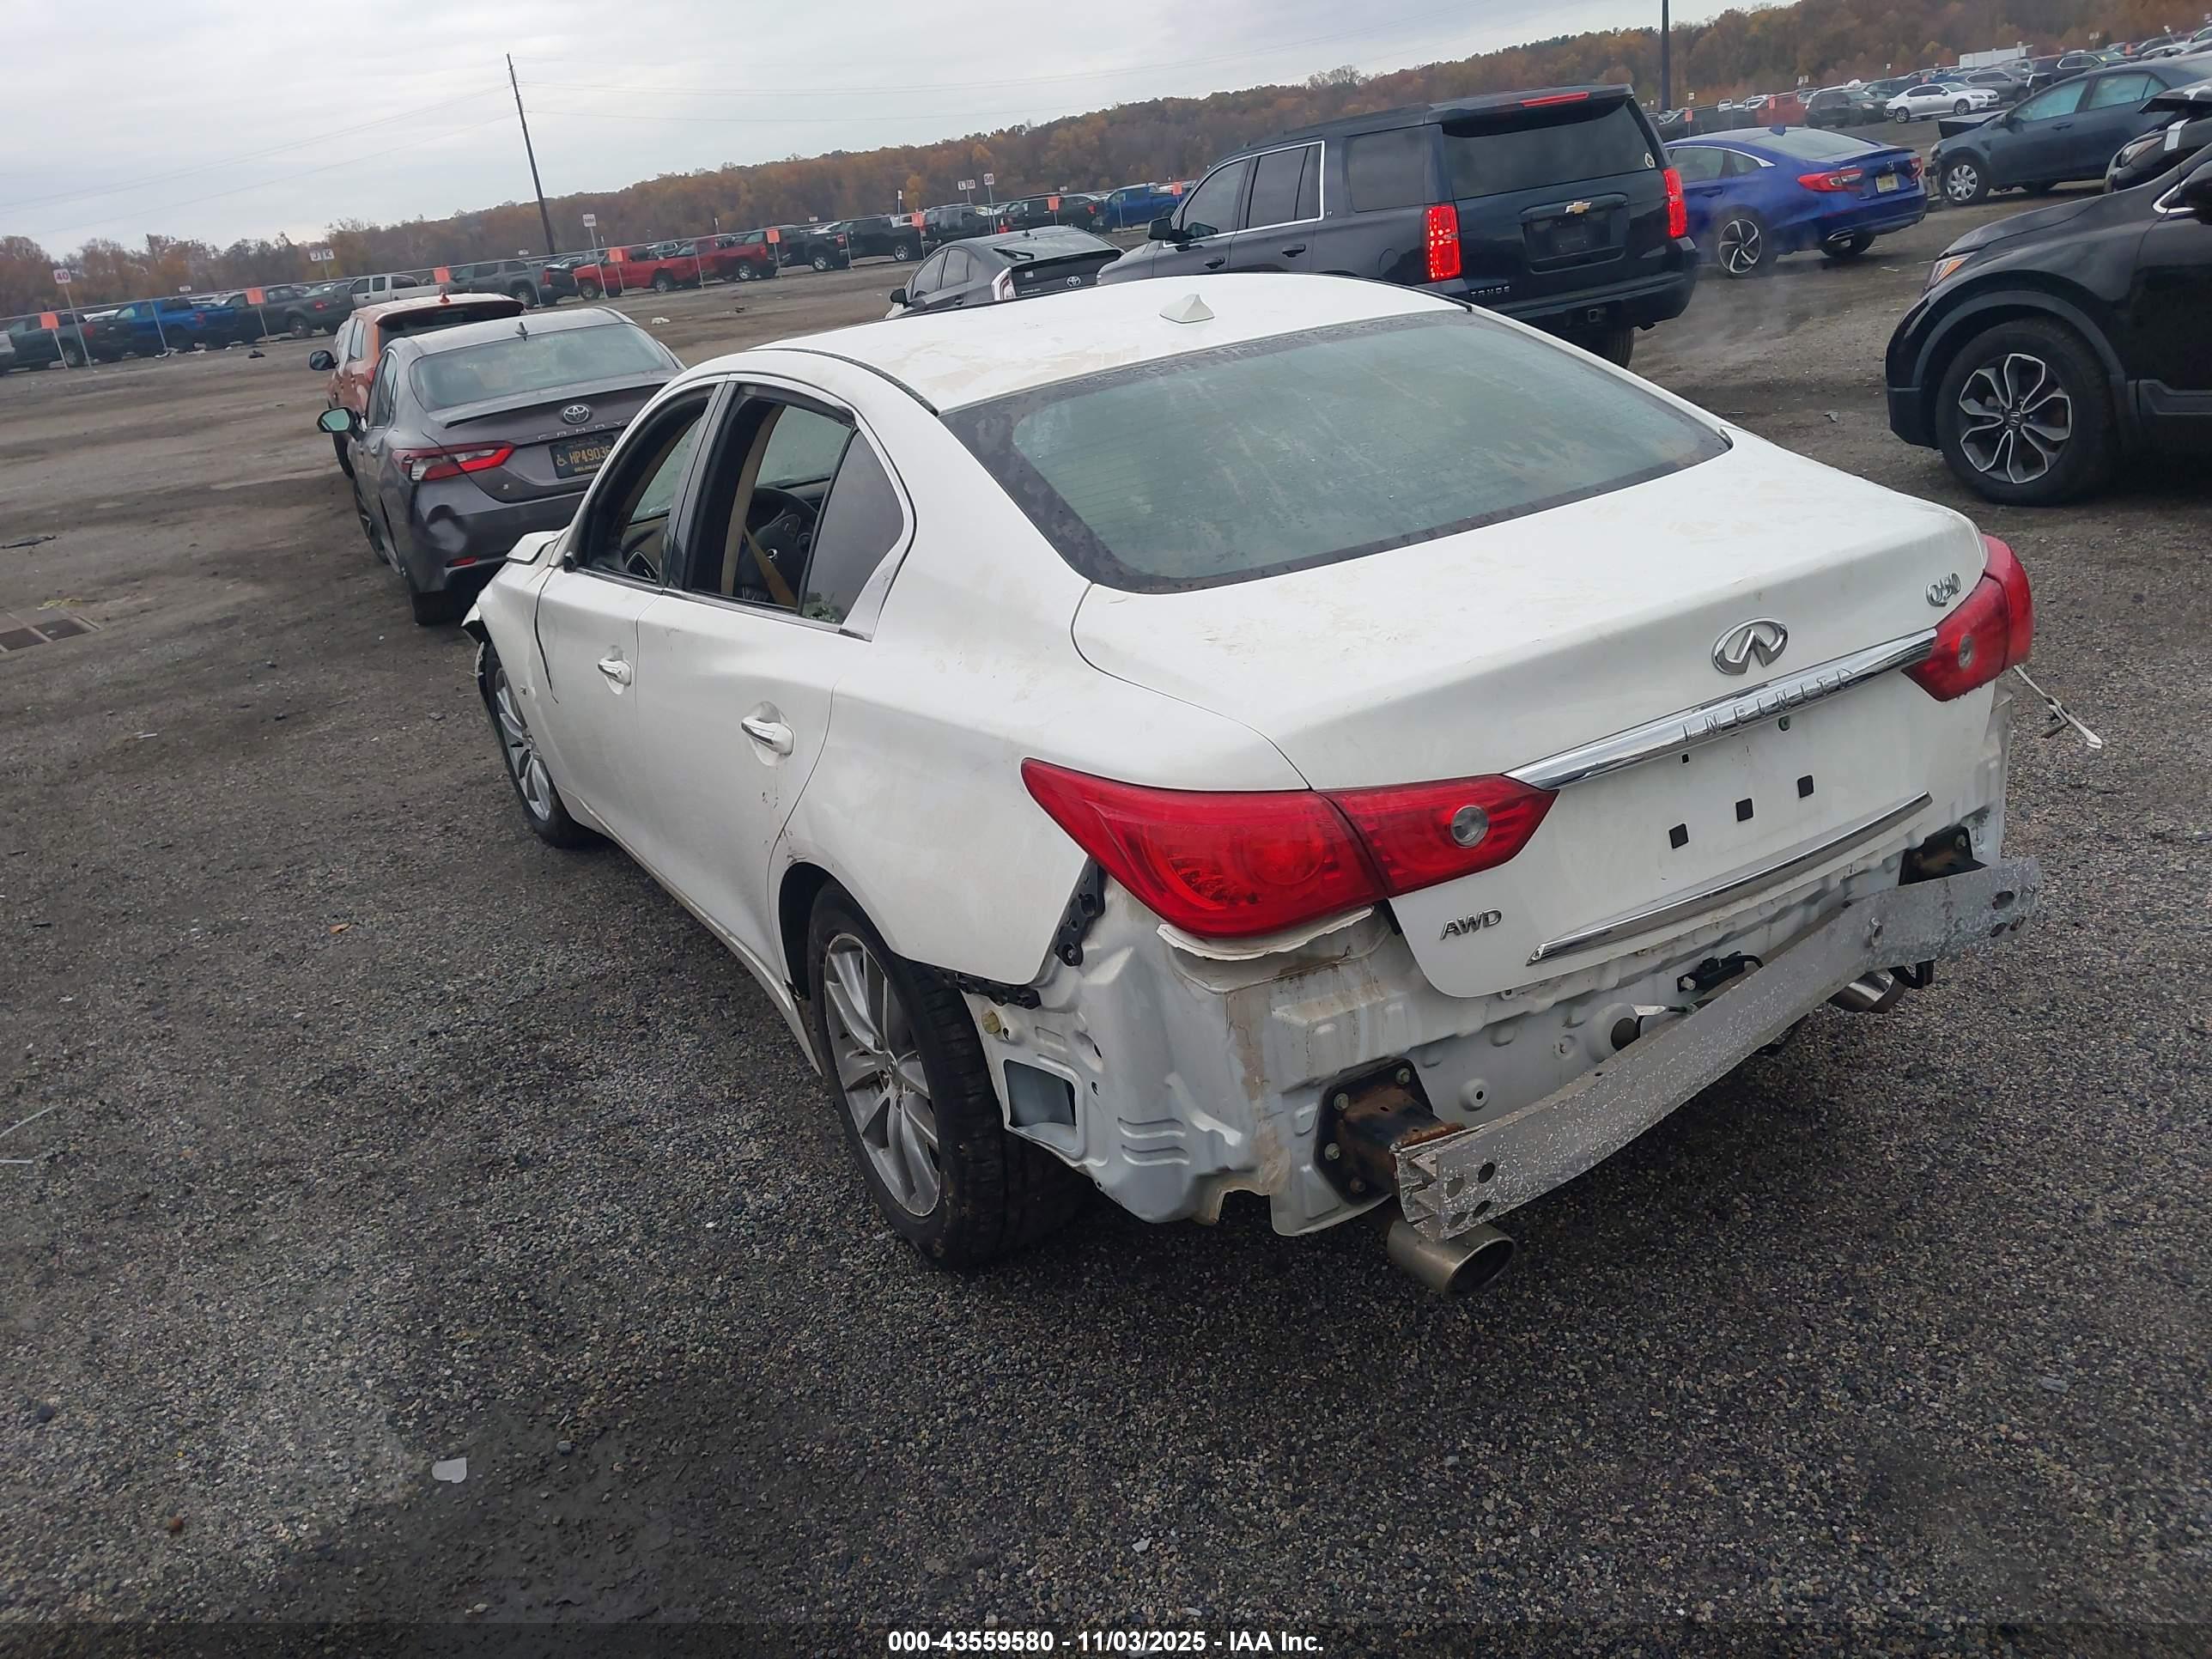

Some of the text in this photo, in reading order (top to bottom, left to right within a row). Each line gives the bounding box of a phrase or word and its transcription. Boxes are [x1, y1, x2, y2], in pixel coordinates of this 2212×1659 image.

[56, 271, 69, 281] 40
[538, 420, 622, 440] CAMRY
[1682, 667, 1853, 742] INFINITI
[1440, 908, 1502, 940] AWD
